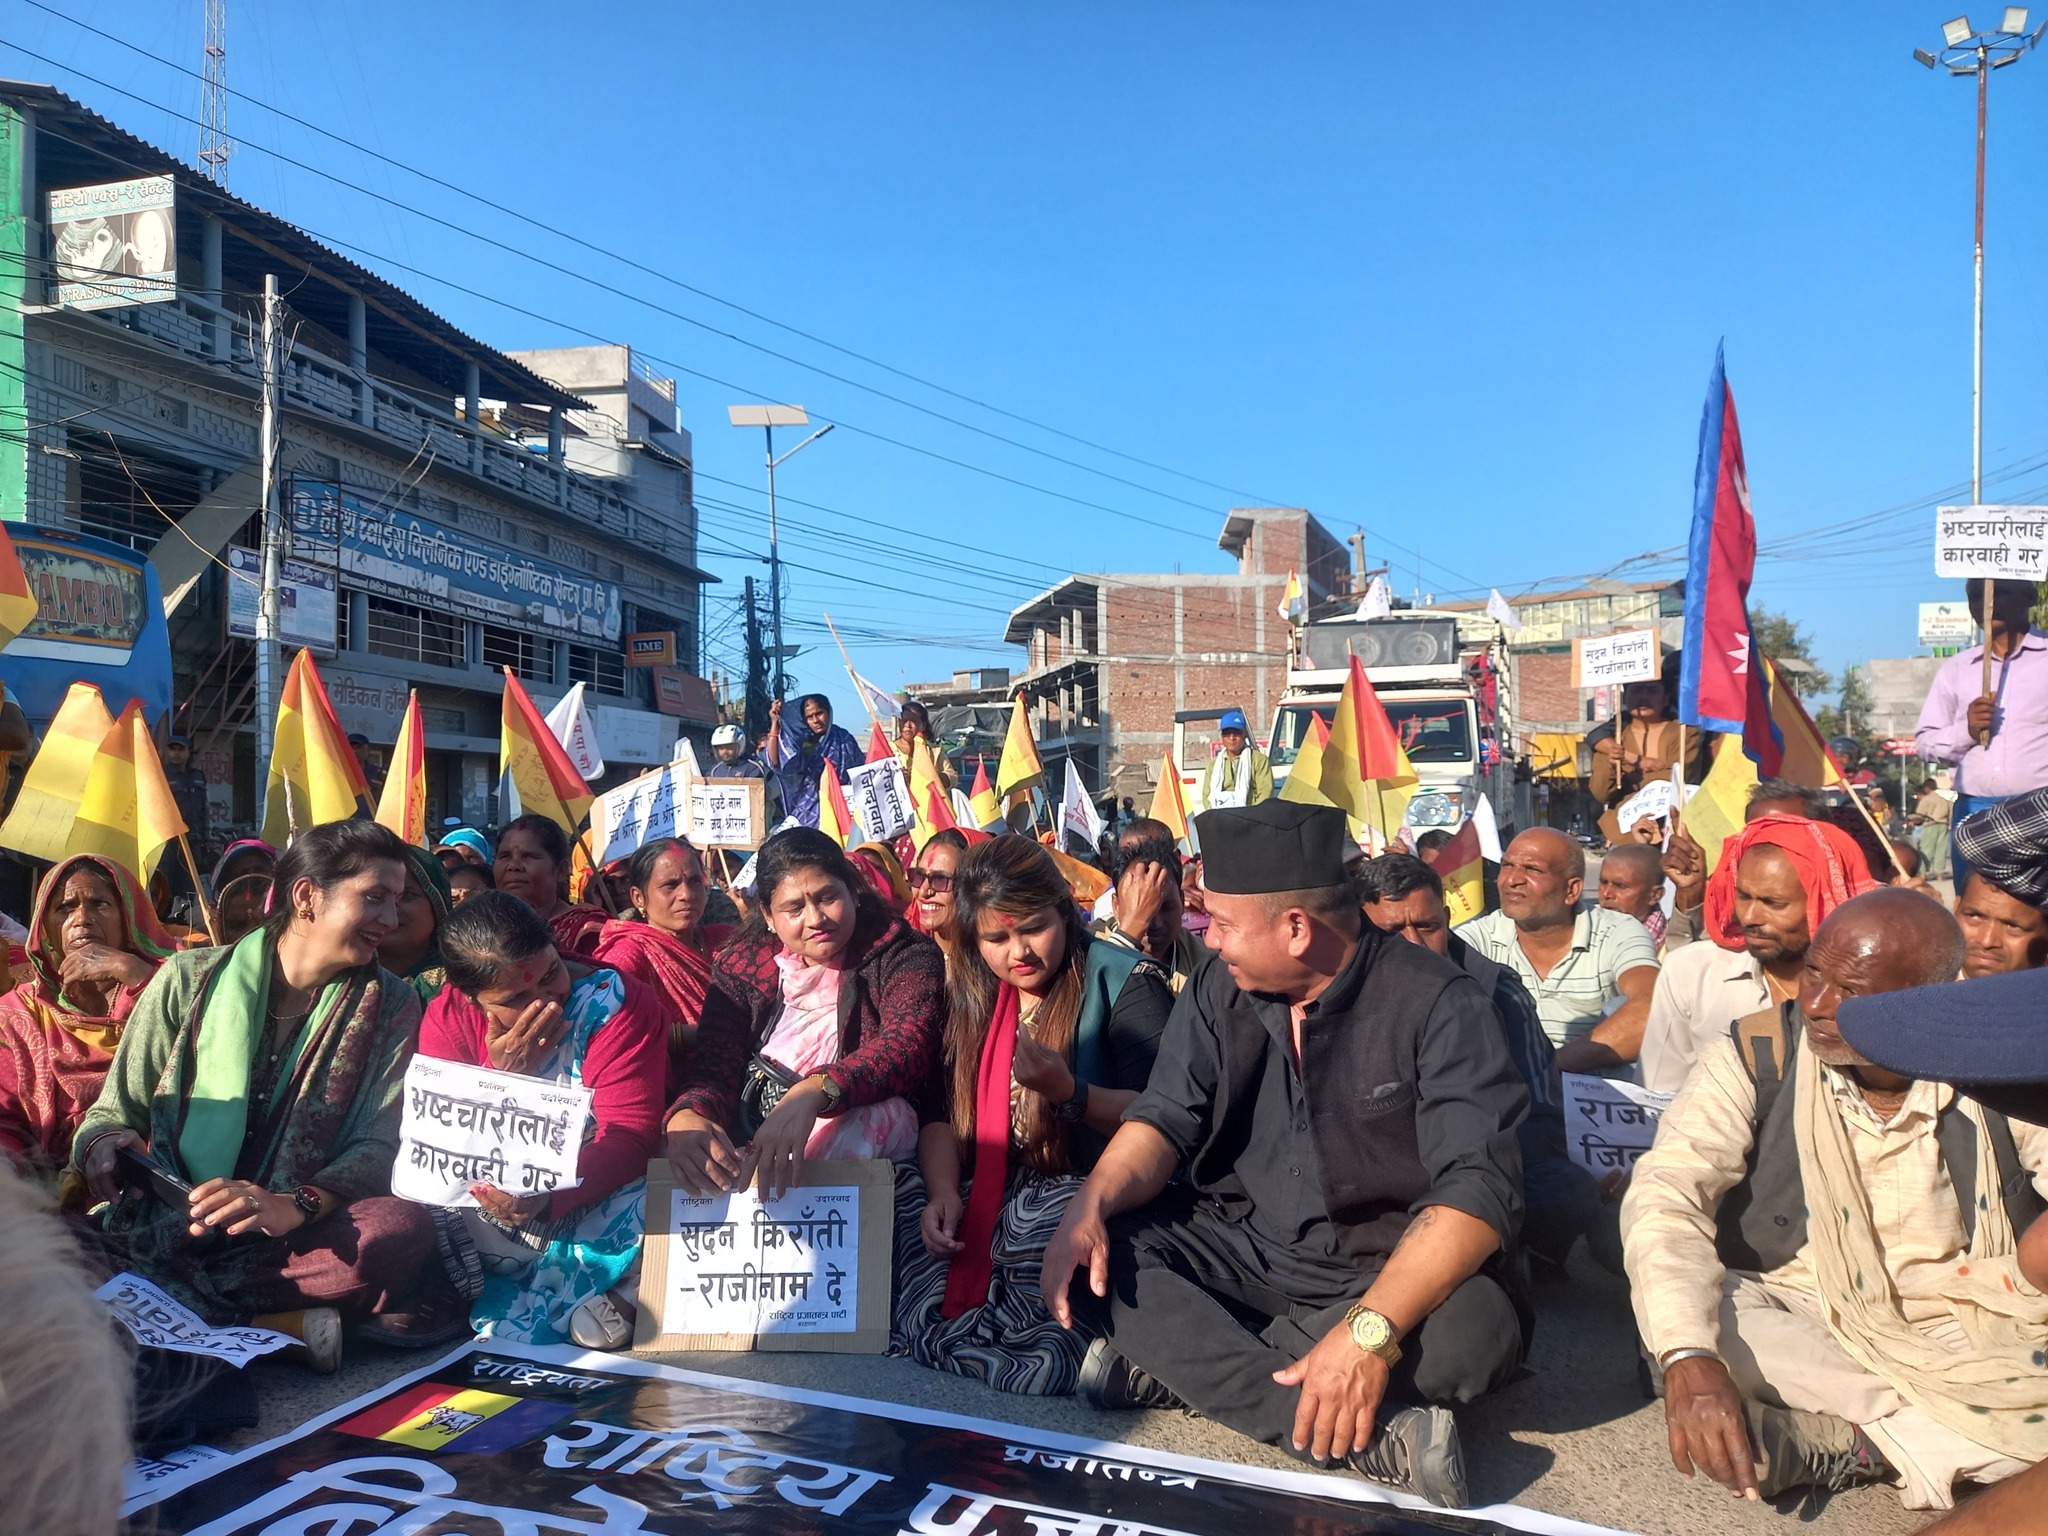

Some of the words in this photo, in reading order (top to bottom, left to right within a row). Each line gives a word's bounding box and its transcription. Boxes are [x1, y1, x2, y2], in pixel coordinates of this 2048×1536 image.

[50, 282, 126, 305] ULTRASOUND
[127, 275, 175, 296] CENTER
[1942, 515, 2048, 540] भ्रष्टचारीलाई
[1943, 543, 2010, 567] कारवाही
[2018, 549, 2043, 568] गर
[23, 569, 125, 629] AMBO
[638, 640, 663, 651] IME
[332, 675, 383, 709] मेडिकल
[411, 1086, 574, 1156] भ्रष्टचारीलाई
[410, 1137, 510, 1186] कारवाही
[522, 1163, 563, 1192] गर
[814, 1194, 851, 1204] उदारवाद
[680, 1221, 738, 1263] सुदन
[751, 1204, 848, 1255] किराँती
[825, 1262, 847, 1307] दे
[542, 1420, 895, 1511] राष्ट्रिय
[1001, 1442, 1201, 1491] प्रजातन्त्र
